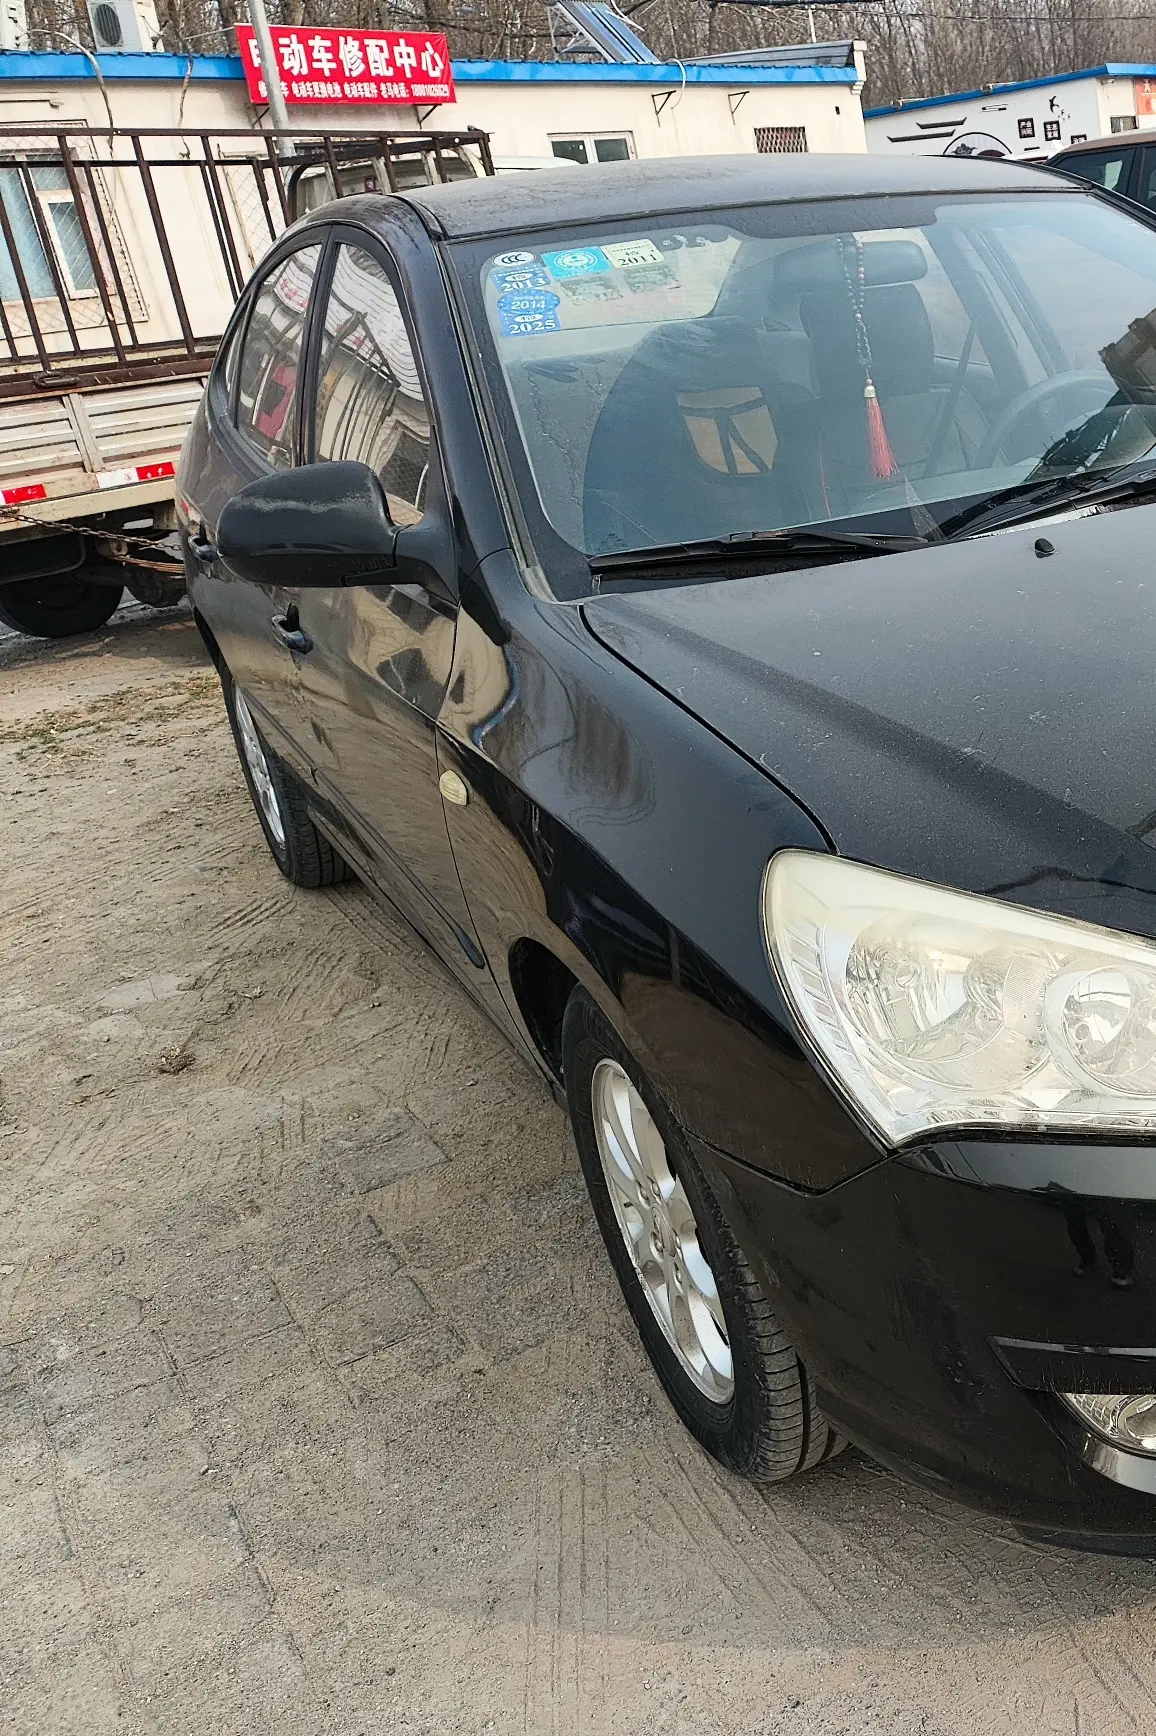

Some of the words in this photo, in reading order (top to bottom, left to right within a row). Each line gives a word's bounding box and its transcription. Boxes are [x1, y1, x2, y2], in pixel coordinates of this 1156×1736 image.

[617, 253, 657, 266] 2011
[501, 278, 546, 292] 2013
[511, 300, 546, 310] 2014
[508, 319, 556, 334] 2025
